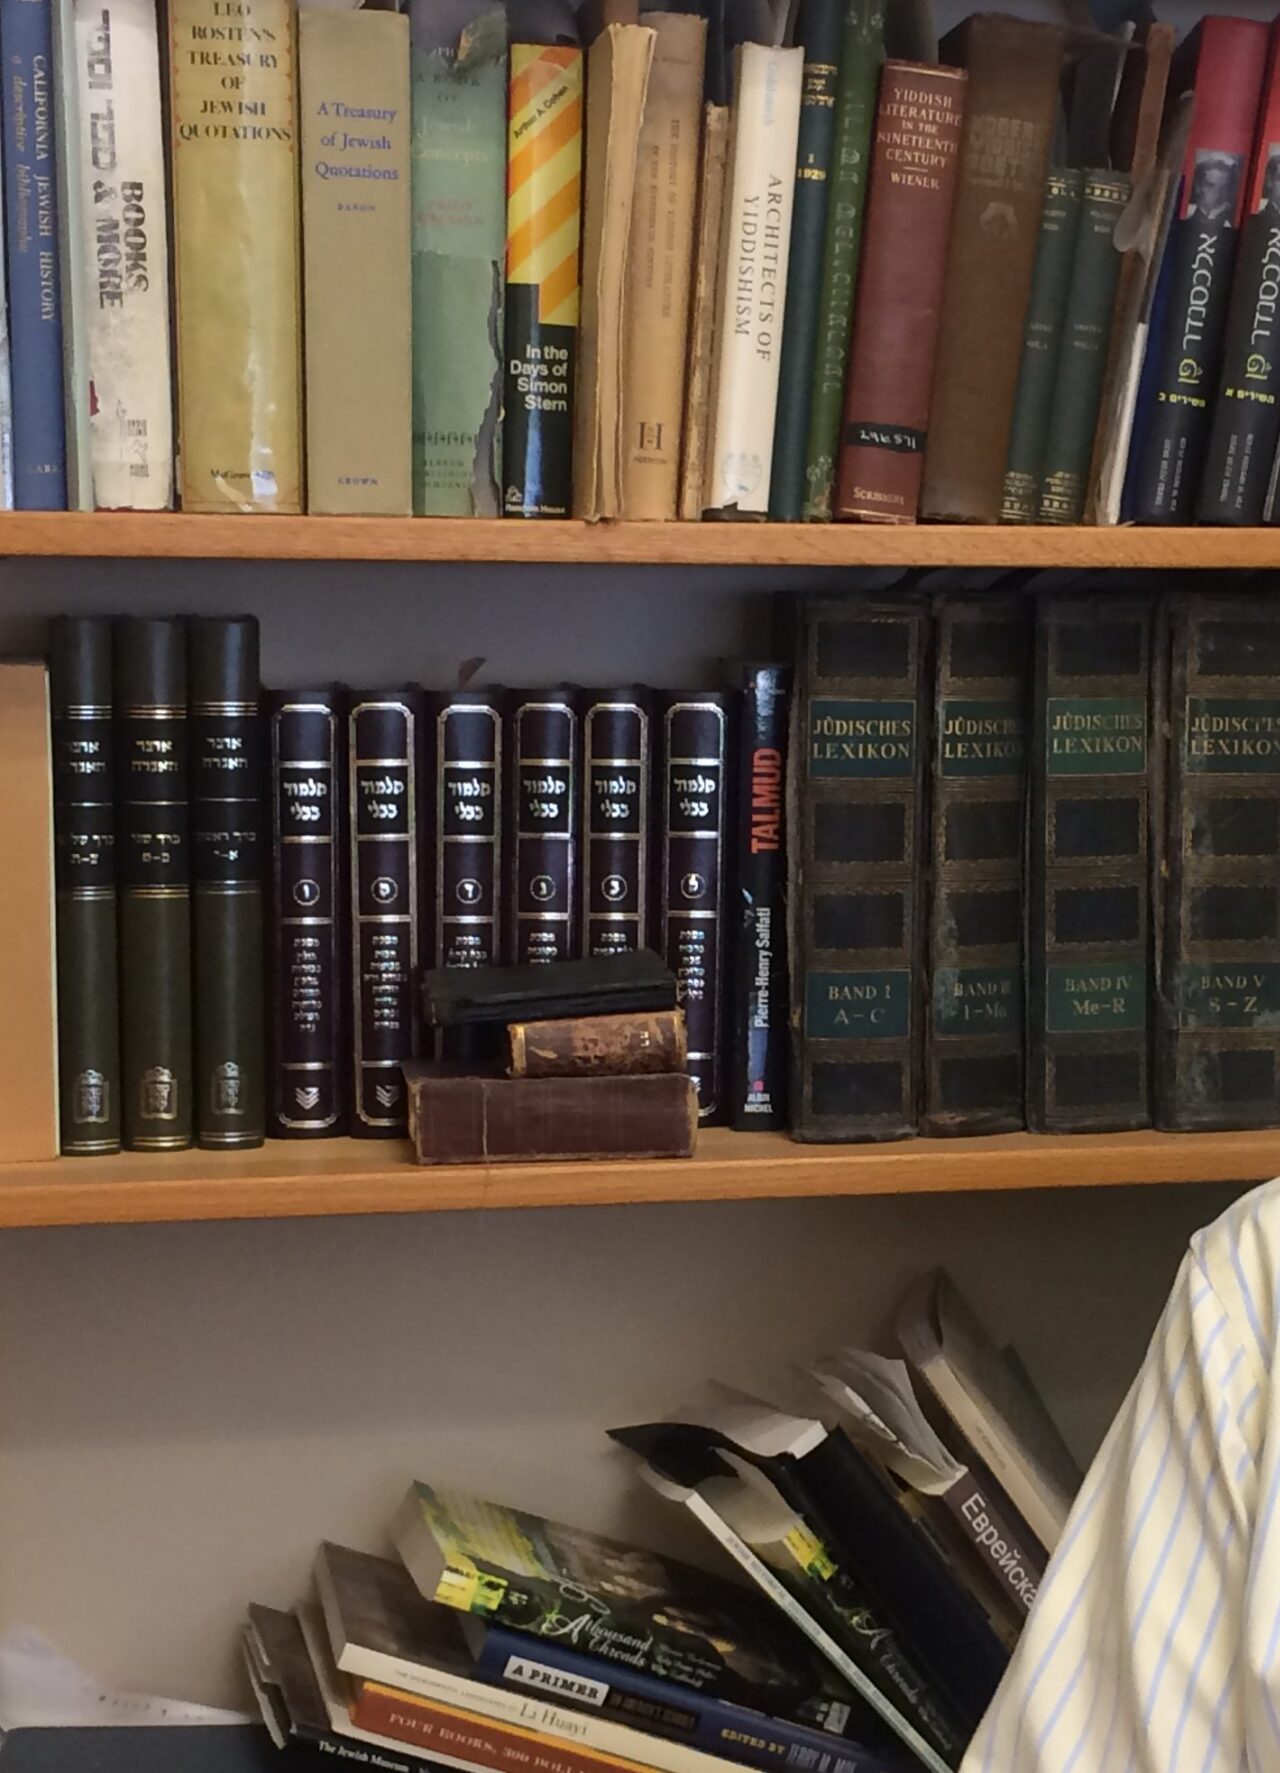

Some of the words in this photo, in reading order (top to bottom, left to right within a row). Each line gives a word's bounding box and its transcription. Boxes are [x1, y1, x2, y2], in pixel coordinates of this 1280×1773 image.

[213, 2, 252, 16] LEO
[186, 49, 278, 68] TREASURY
[221, 76, 245, 90] OF
[33, 54, 49, 161] CALIFORNIA
[893, 87, 953, 109] YIDDISH
[201, 100, 266, 116] JEWISH
[317, 102, 329, 116] A
[331, 102, 398, 125] Treasury
[880, 102, 963, 127] LITERATURE
[180, 123, 292, 141] QUOTATIONS
[901, 119, 914, 130] IN
[918, 122, 939, 134] THE
[320, 131, 339, 147] of
[339, 132, 392, 151] Jewish
[876, 131, 959, 154] NINETEENTH
[885, 147, 948, 168] CENTURY
[315, 161, 399, 181] Quotations
[890, 171, 940, 190] WIENER
[34, 174, 51, 237] JEWISH
[121, 181, 149, 292] BOOKS
[757, 174, 784, 323] ARCHITECTS
[96, 216, 124, 309] MORE
[734, 195, 760, 336] YIDDISHISM
[39, 250, 56, 321] HISTORY
[526, 344, 541, 359] In
[544, 345, 568, 360] the
[755, 330, 772, 362] OF
[510, 359, 549, 378] Days
[552, 362, 568, 376] of
[517, 376, 567, 394] Simon
[524, 394, 567, 412] Stern
[812, 715, 913, 737] JÜDISCHES
[1052, 711, 1143, 732] JÜDISCHES
[812, 741, 912, 760] LEXIKON
[1052, 736, 1143, 755] LEXIKON
[69, 761, 106, 774] האגד
[284, 780, 327, 797] תלמוד
[361, 780, 404, 797] תלמוד
[448, 779, 491, 798] תלמוד
[523, 779, 565, 796] תלמוד
[595, 779, 636, 796] תלמוד
[673, 772, 715, 794] תלמוד
[529, 801, 558, 819] בבלי
[601, 801, 630, 819] בבלי
[679, 800, 709, 817] בבלי
[751, 747, 784, 855] TALMUD
[290, 804, 321, 822] בבלי
[366, 804, 398, 822] בבלי
[455, 803, 484, 822] בבלי
[756, 906, 773, 947] Salfati
[753, 948, 773, 1028] Pierre-Henry
[954, 981, 999, 998] BAND
[1064, 975, 1112, 993] BAND
[1115, 974, 1132, 990] IV
[1200, 974, 1247, 990] BAND
[1250, 974, 1266, 989] V
[828, 984, 879, 1000] BAND
[511, 1665, 525, 1677] A
[528, 1670, 600, 1700] PRIMER
[389, 1713, 432, 1735] FOUR
[438, 1727, 498, 1757] BOOKS,
[720, 1728, 765, 1748] EDITED
[766, 1743, 785, 1756] BY
[319, 1740, 336, 1754] The
[337, 1743, 369, 1764] Jewish
